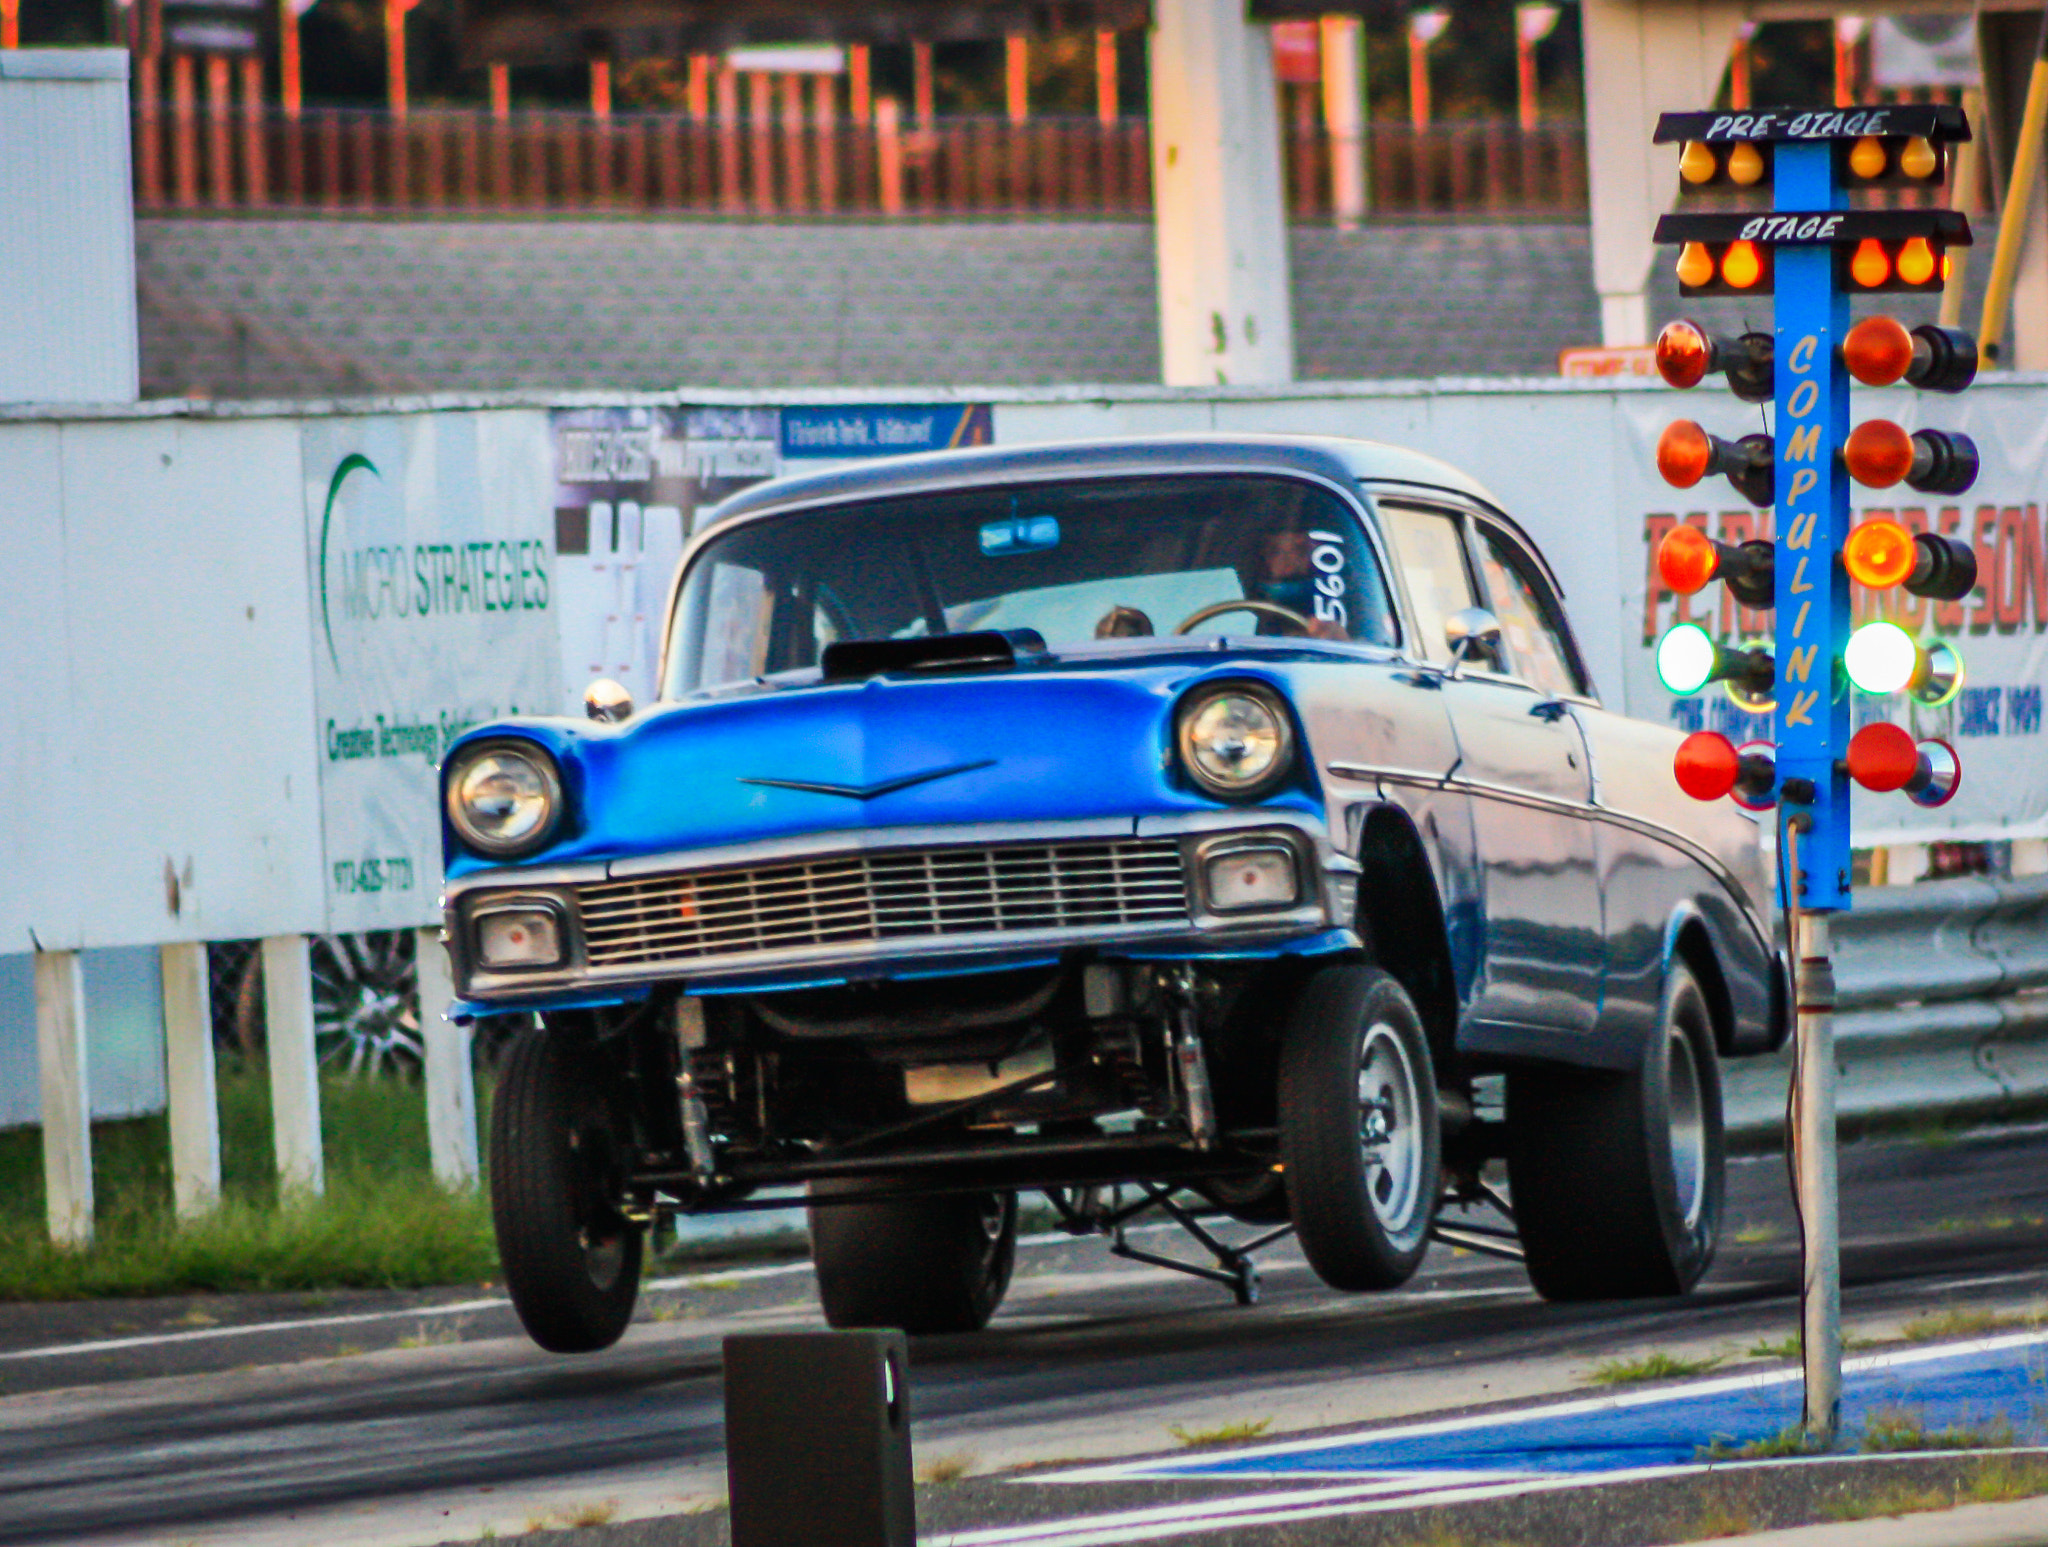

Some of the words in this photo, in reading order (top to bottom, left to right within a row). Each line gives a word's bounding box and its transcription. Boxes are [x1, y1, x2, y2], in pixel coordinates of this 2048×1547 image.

[1705, 110, 1891, 140] PRE-STAGE
[1739, 215, 1844, 241] STAGE
[1783, 334, 1823, 728] COMPULINK
[340, 547, 410, 621] MICRO
[414, 539, 550, 618] STRATEGIES
[1308, 529, 1348, 629] 5601
